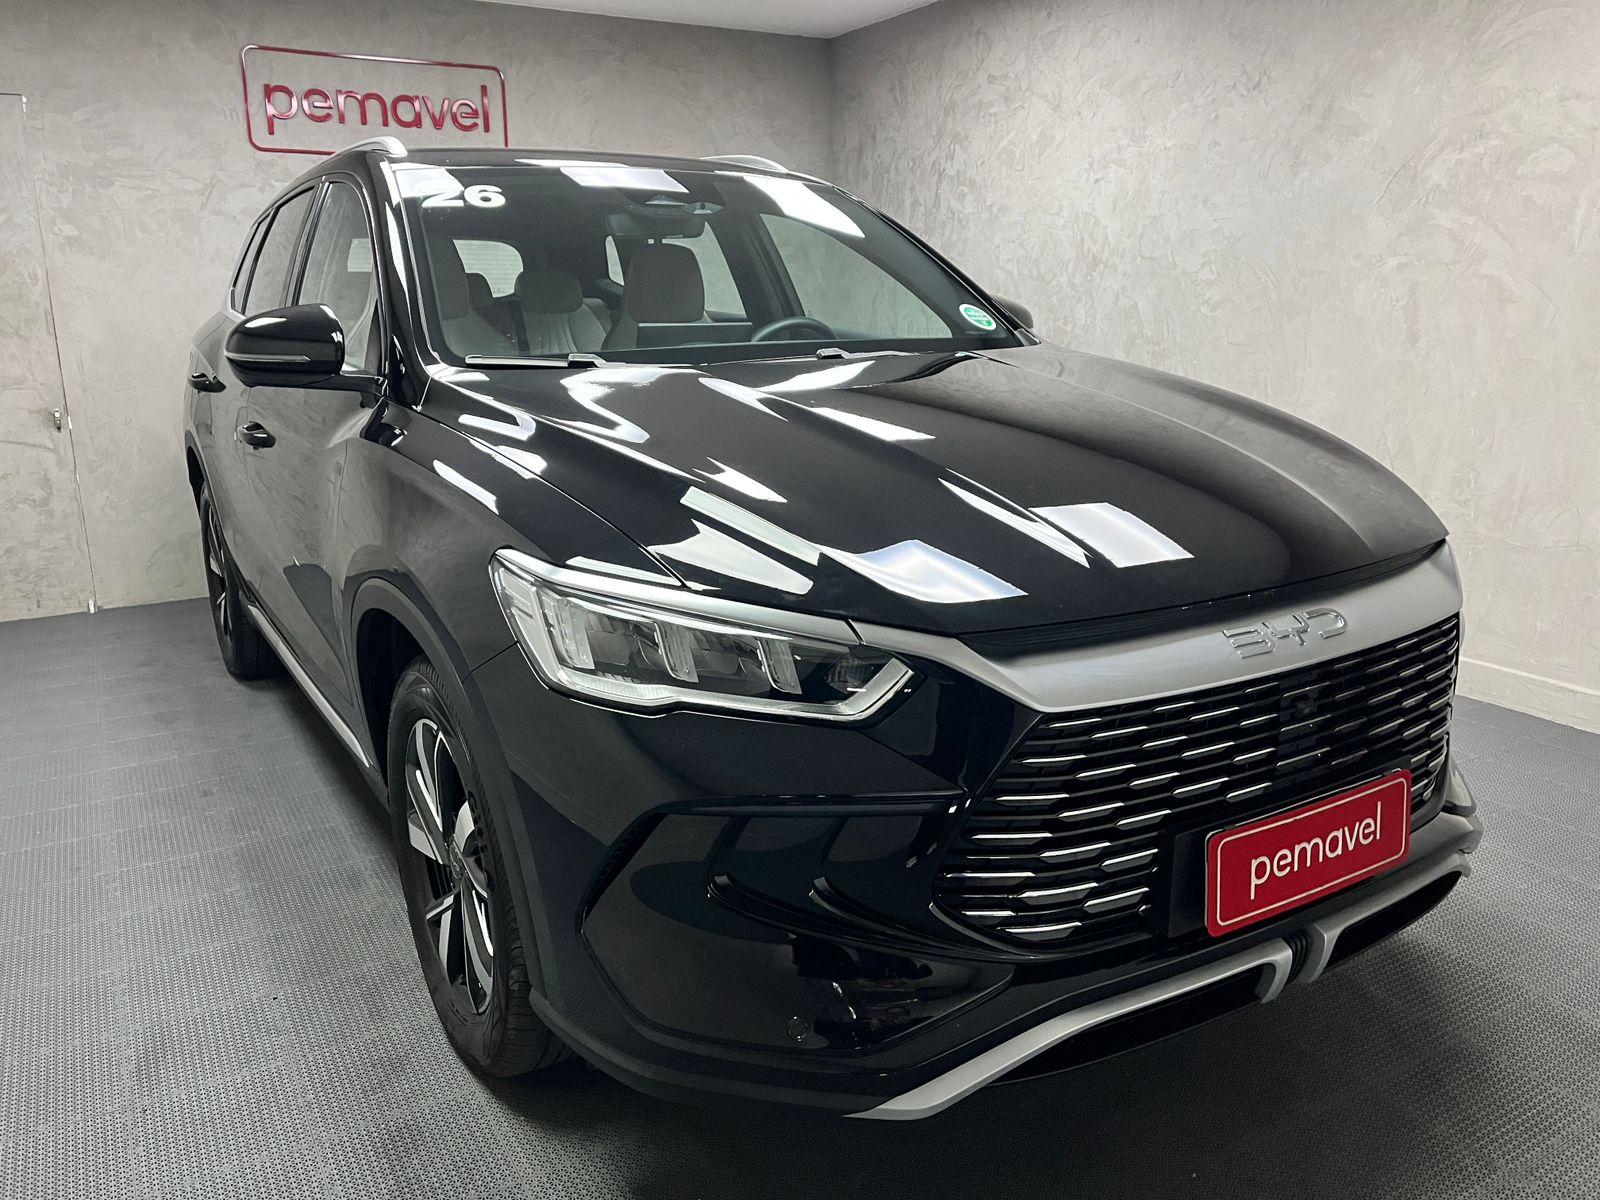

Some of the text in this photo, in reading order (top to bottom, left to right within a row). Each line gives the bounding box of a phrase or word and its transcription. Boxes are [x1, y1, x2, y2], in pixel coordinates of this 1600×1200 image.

[263, 83, 491, 135] pemavel
[1222, 607, 1349, 659] BYD
[1250, 801, 1382, 900] pemavel
